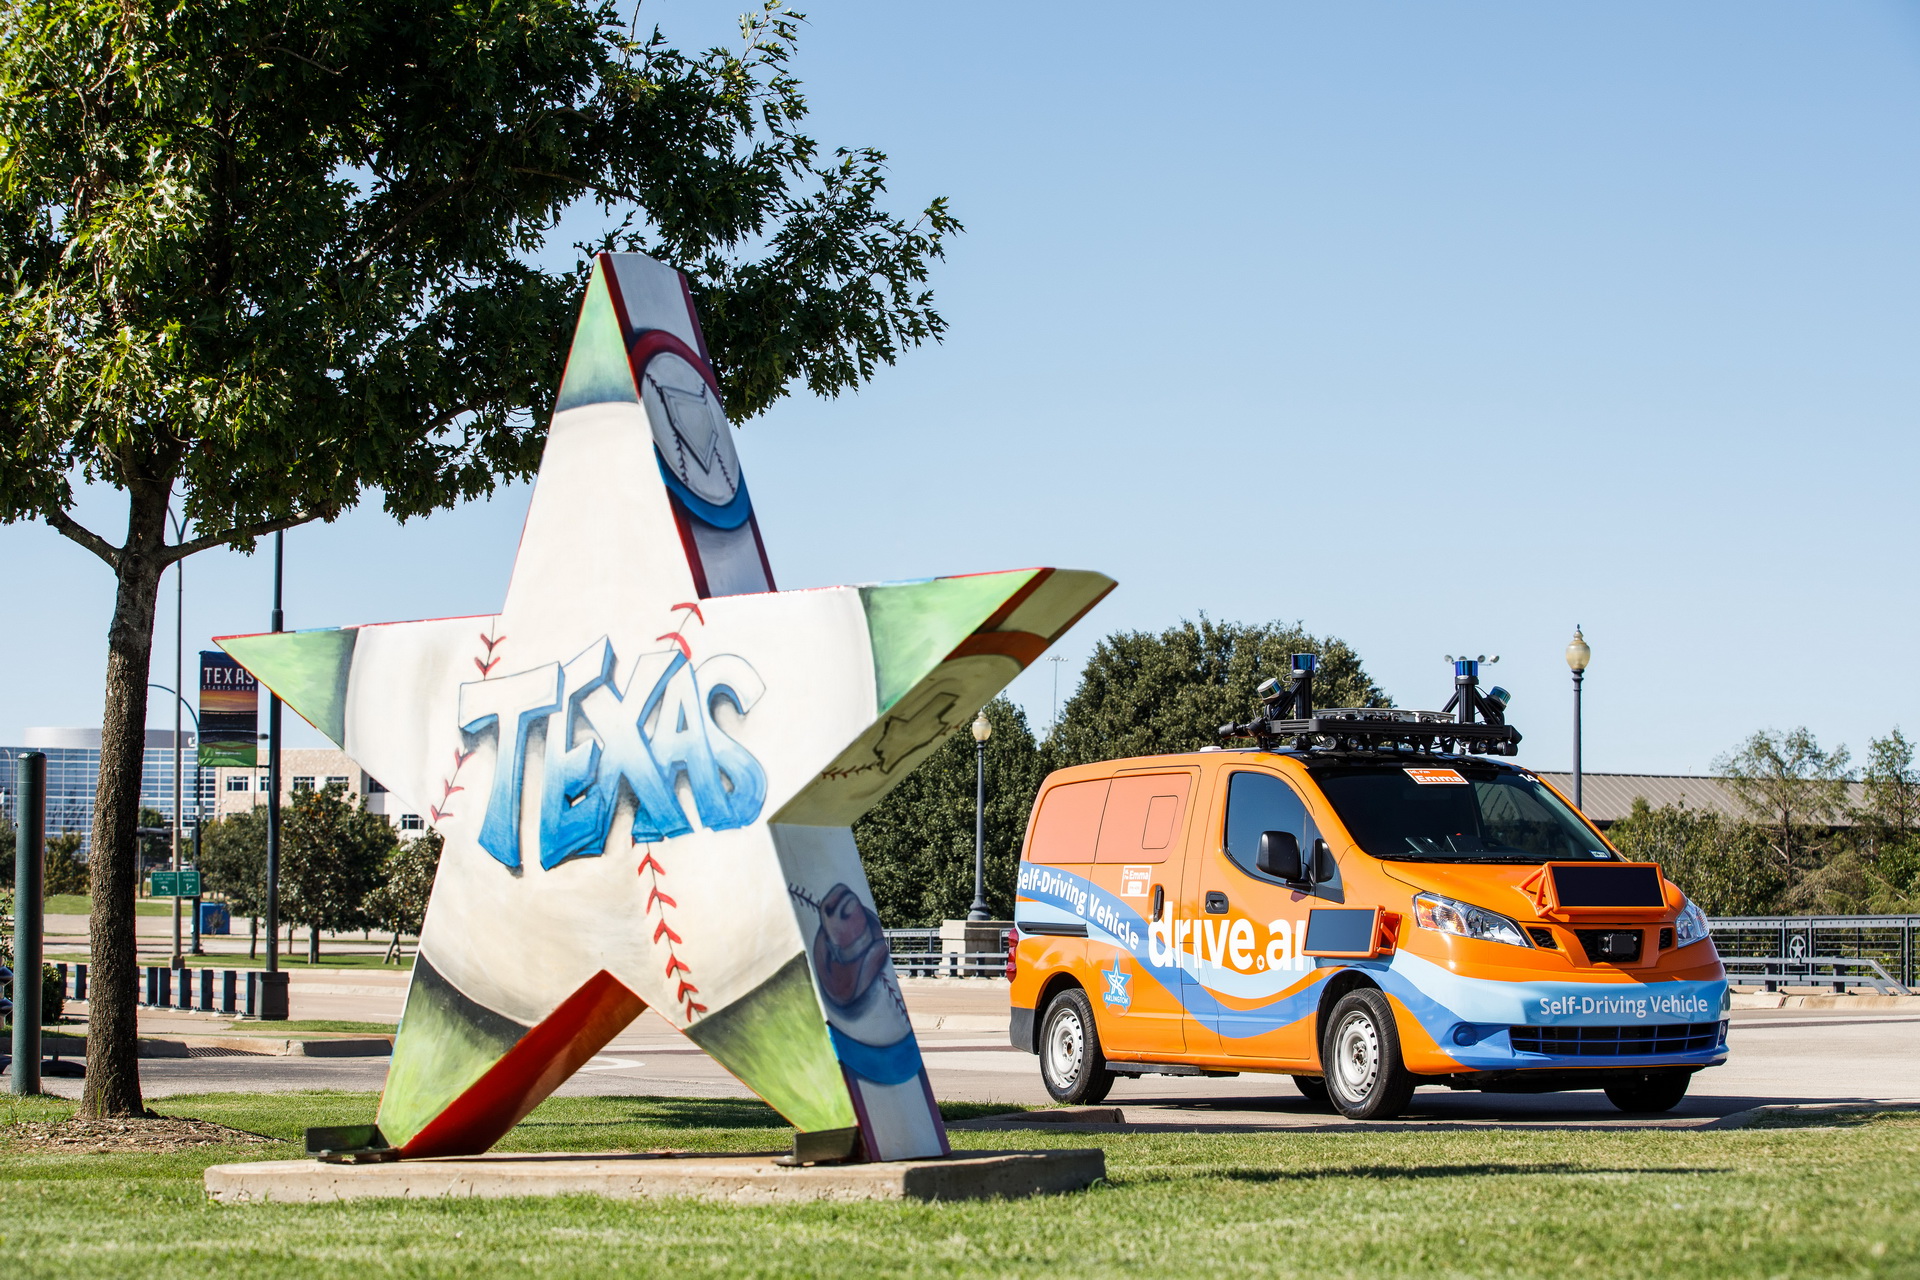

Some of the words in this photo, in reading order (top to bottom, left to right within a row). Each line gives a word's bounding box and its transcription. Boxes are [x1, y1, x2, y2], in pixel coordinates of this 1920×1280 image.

[204, 667, 255, 685] TEXAS
[459, 634, 768, 871] TEXAS
[1414, 775, 1463, 783] Emma
[1518, 773, 1540, 784] 14
[1129, 870, 1149, 880] Emma
[1017, 867, 1088, 916] Self-Driving
[1089, 893, 1140, 951] Vehicle
[1104, 993, 1130, 1005] ARLINGTON
[1539, 996, 1647, 1019] Self-Driving
[1650, 995, 1709, 1013] Vehicle
